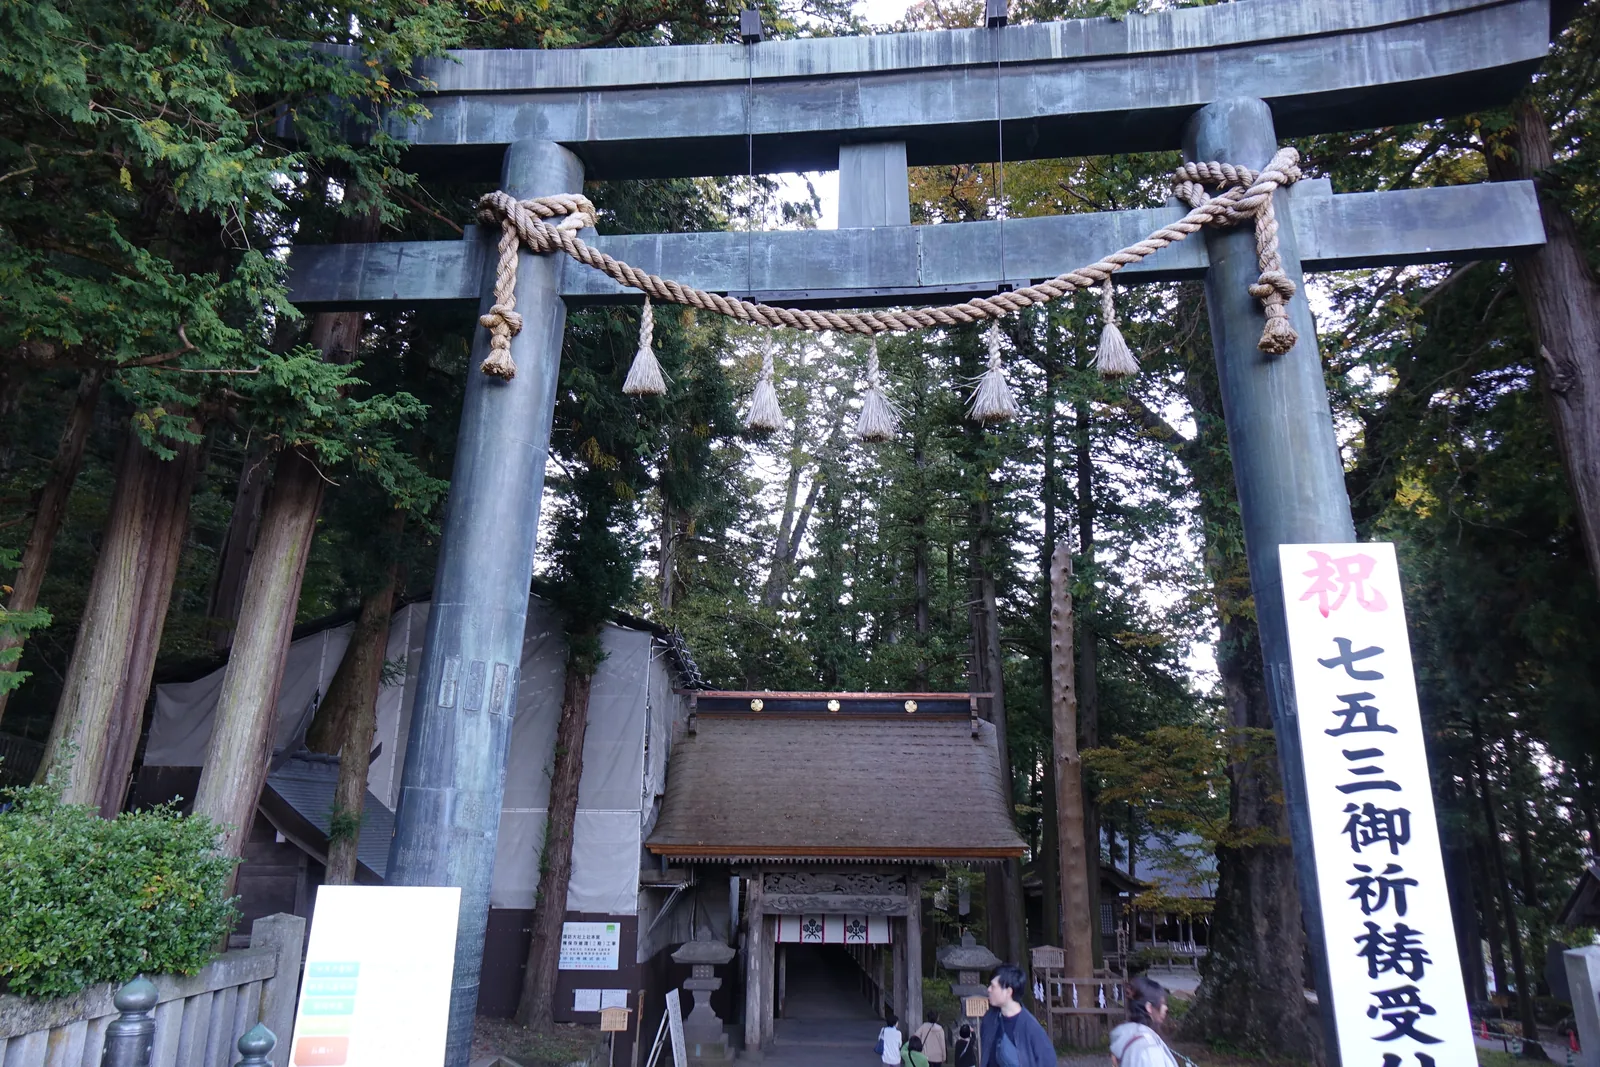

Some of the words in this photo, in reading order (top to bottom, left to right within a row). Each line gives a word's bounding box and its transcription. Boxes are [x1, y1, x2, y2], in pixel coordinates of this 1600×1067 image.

[1299, 550, 1388, 618] 祝
[1318, 638, 1443, 1067] 七五三御祈祷受
